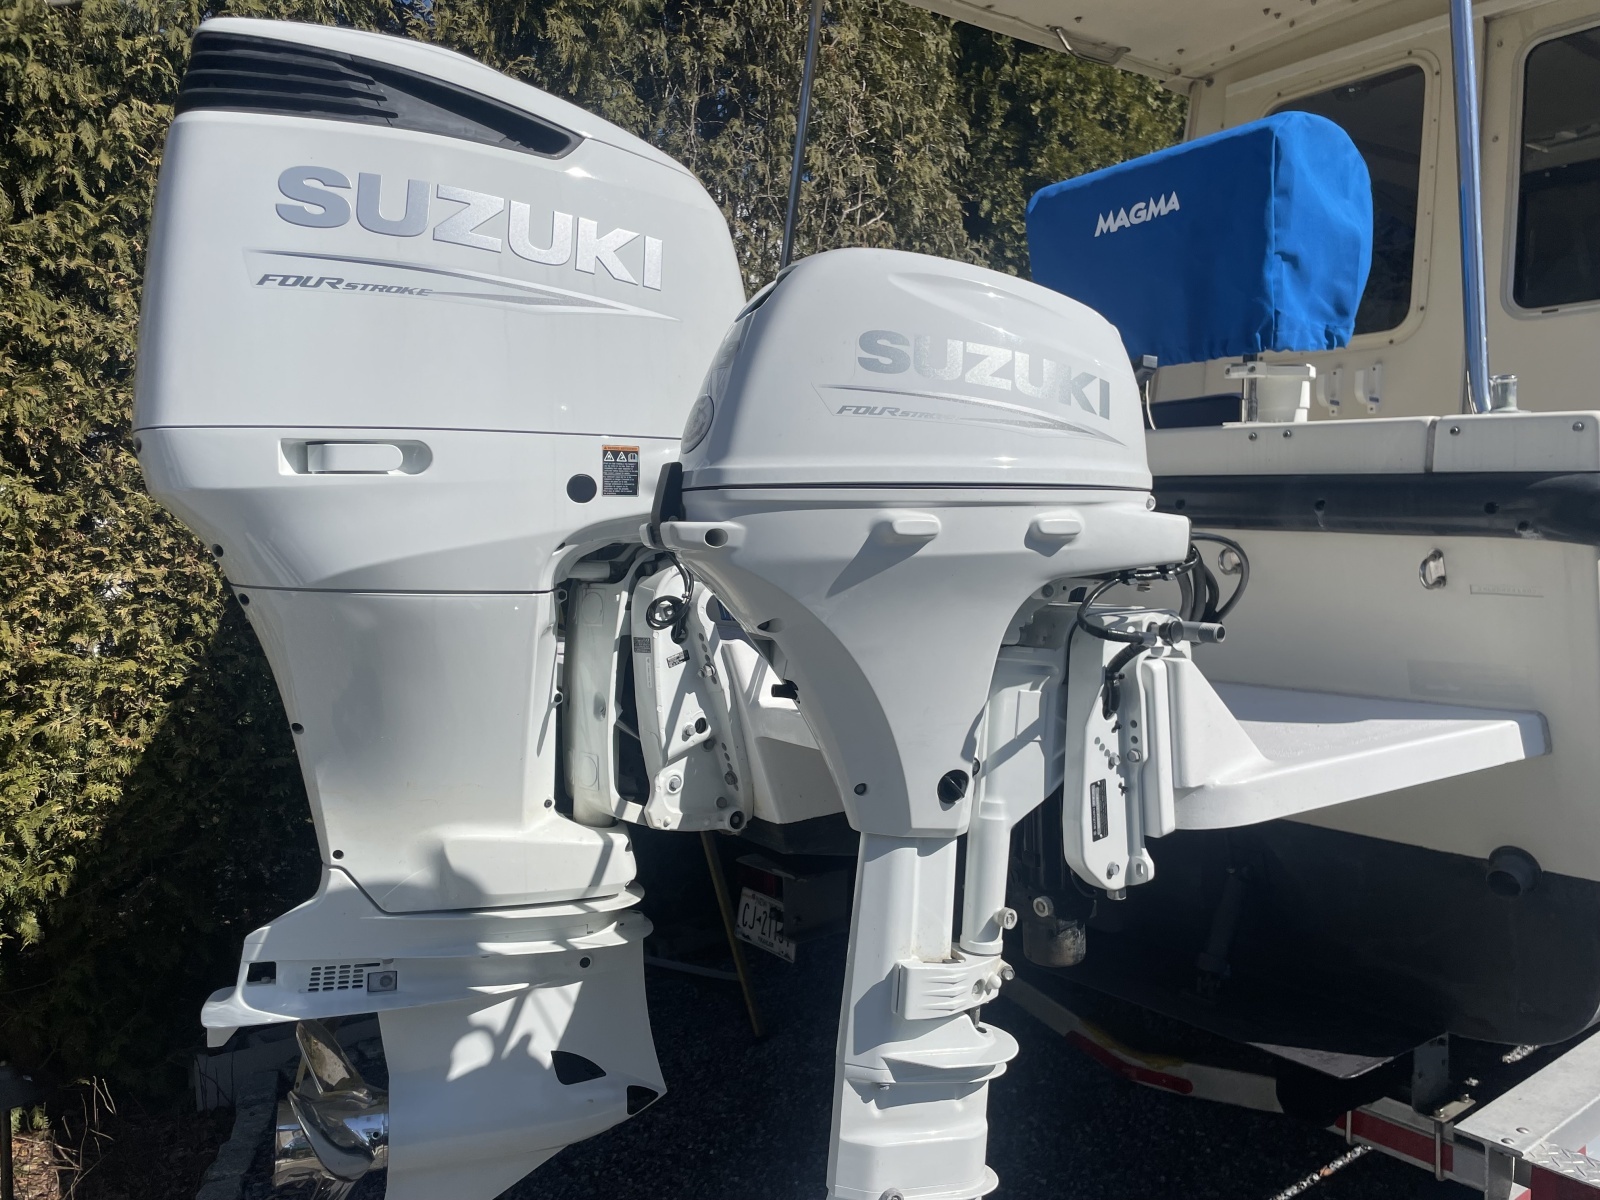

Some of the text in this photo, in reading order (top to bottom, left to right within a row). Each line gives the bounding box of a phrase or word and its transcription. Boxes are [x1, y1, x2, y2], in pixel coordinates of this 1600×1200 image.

[275, 165, 664, 291] SUZUKI
[1094, 191, 1181, 238] MAGMA
[256, 273, 433, 297] FOUR STROKE
[857, 329, 1111, 421] SUZUKI
[836, 405, 901, 417] FOUR
